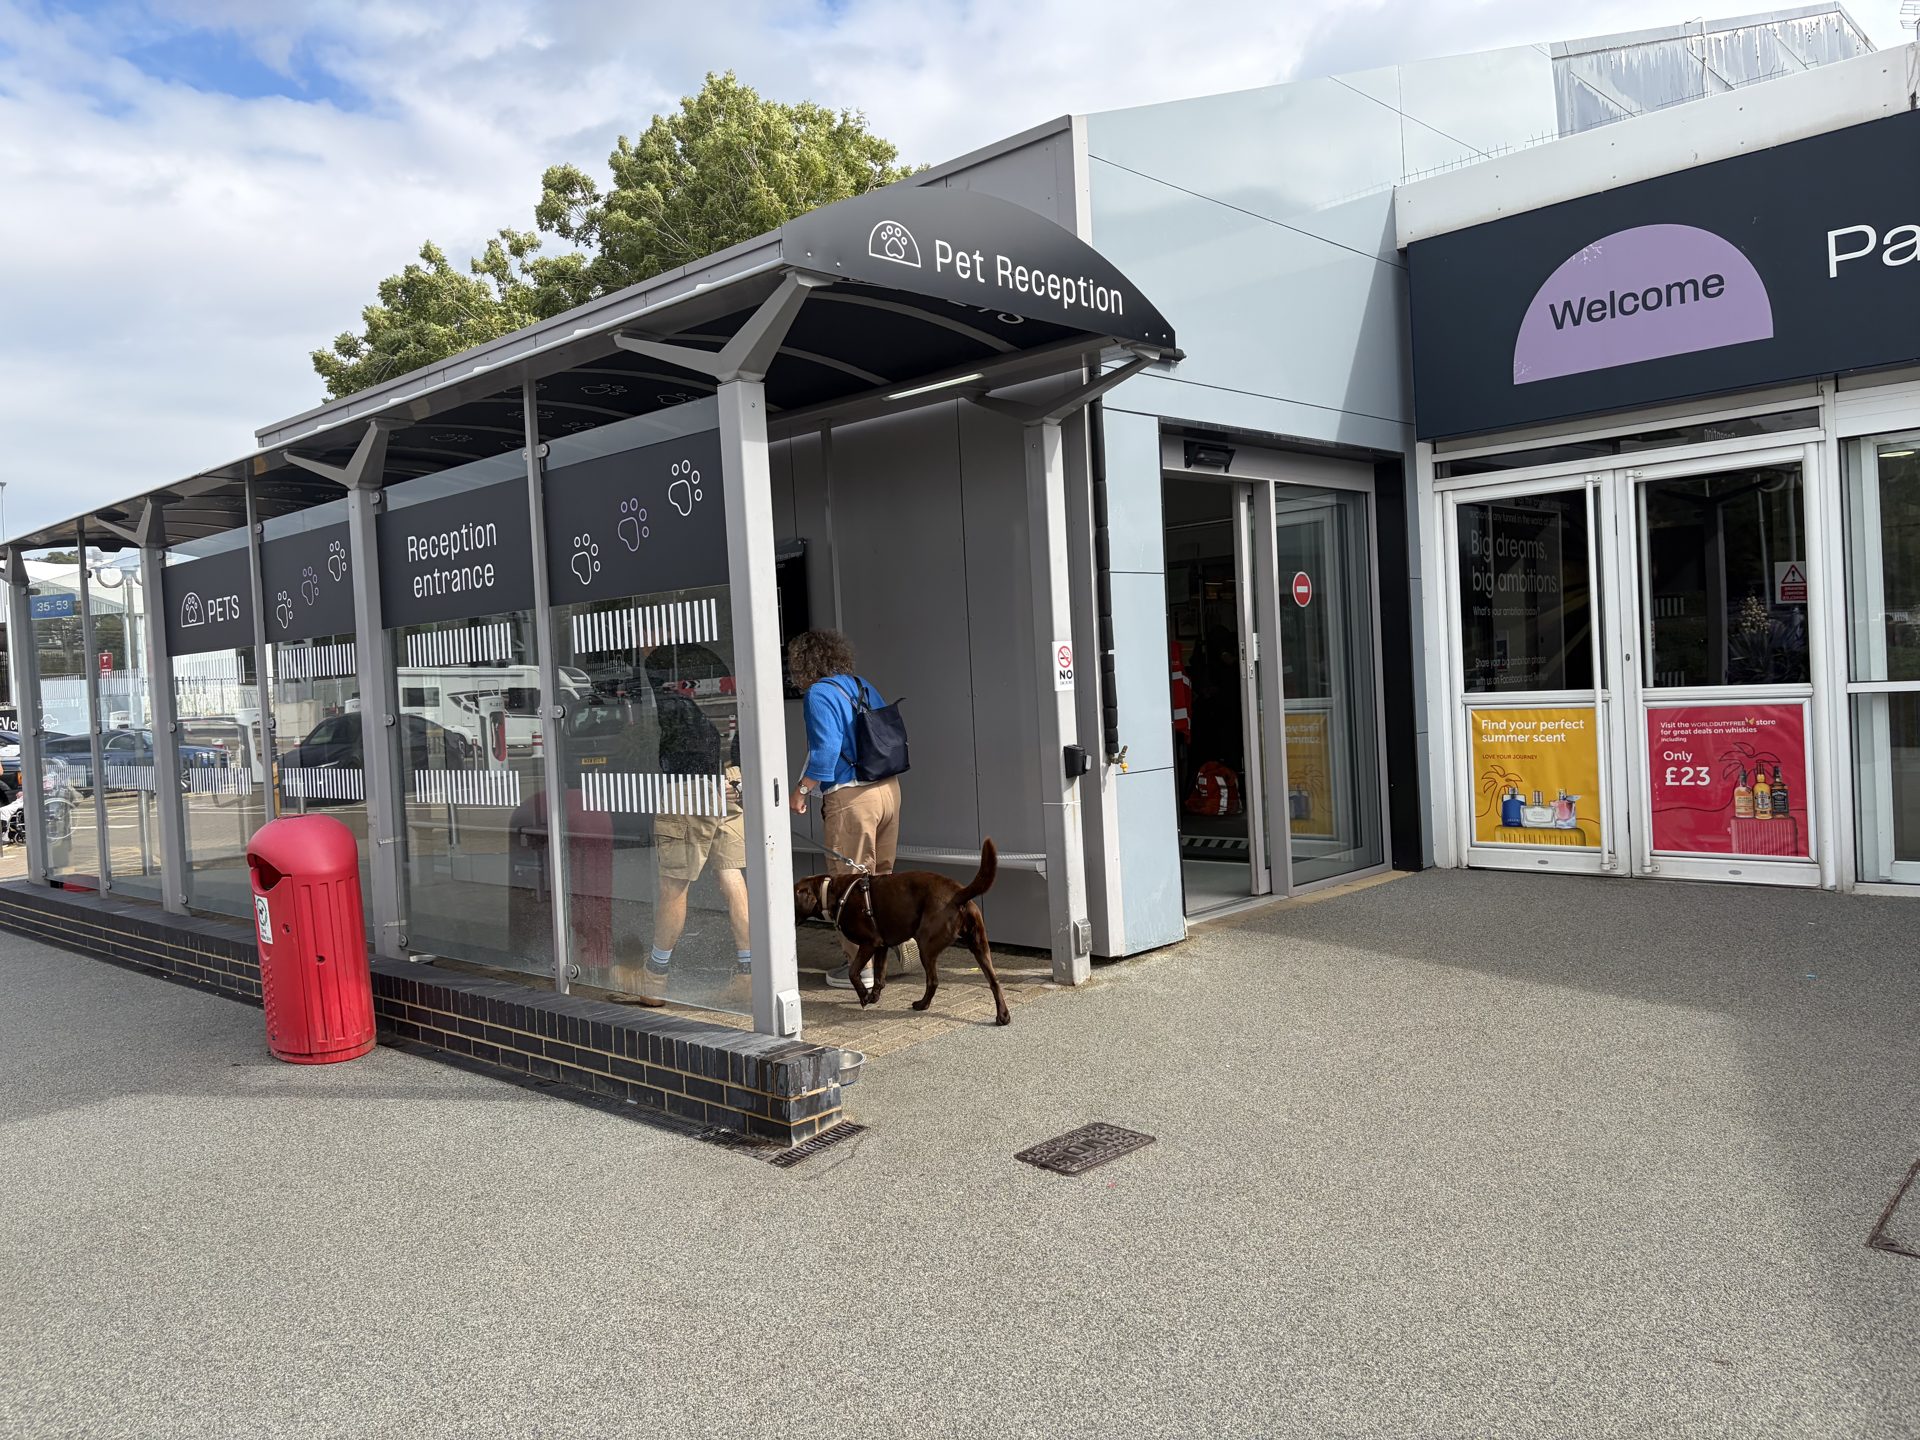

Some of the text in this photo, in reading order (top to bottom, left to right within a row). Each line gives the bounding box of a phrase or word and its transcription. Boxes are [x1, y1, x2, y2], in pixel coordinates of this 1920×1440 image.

[1827, 224, 1920, 279] Pa
[934, 239, 986, 283] Pet
[996, 254, 1125, 316] Reception
[1549, 272, 1725, 331] Welcome
[407, 521, 497, 563] Reception
[1471, 529, 1547, 563] Big dreams,
[413, 563, 495, 599] entrance
[1472, 565, 1559, 599] big ambitions.
[207, 594, 240, 624] PETS
[1059, 669, 1073, 680] NO
[1482, 718, 1585, 732] Find your perfect
[1482, 732, 1566, 743] summer scent
[1660, 721, 1676, 729] Visit
[1755, 718, 1776, 726] store
[1672, 728, 1692, 737] great
[1693, 726, 1713, 735] deals
[1725, 725, 1758, 734] whiskies
[1663, 750, 1693, 763] Only
[1664, 766, 1711, 786] £23
